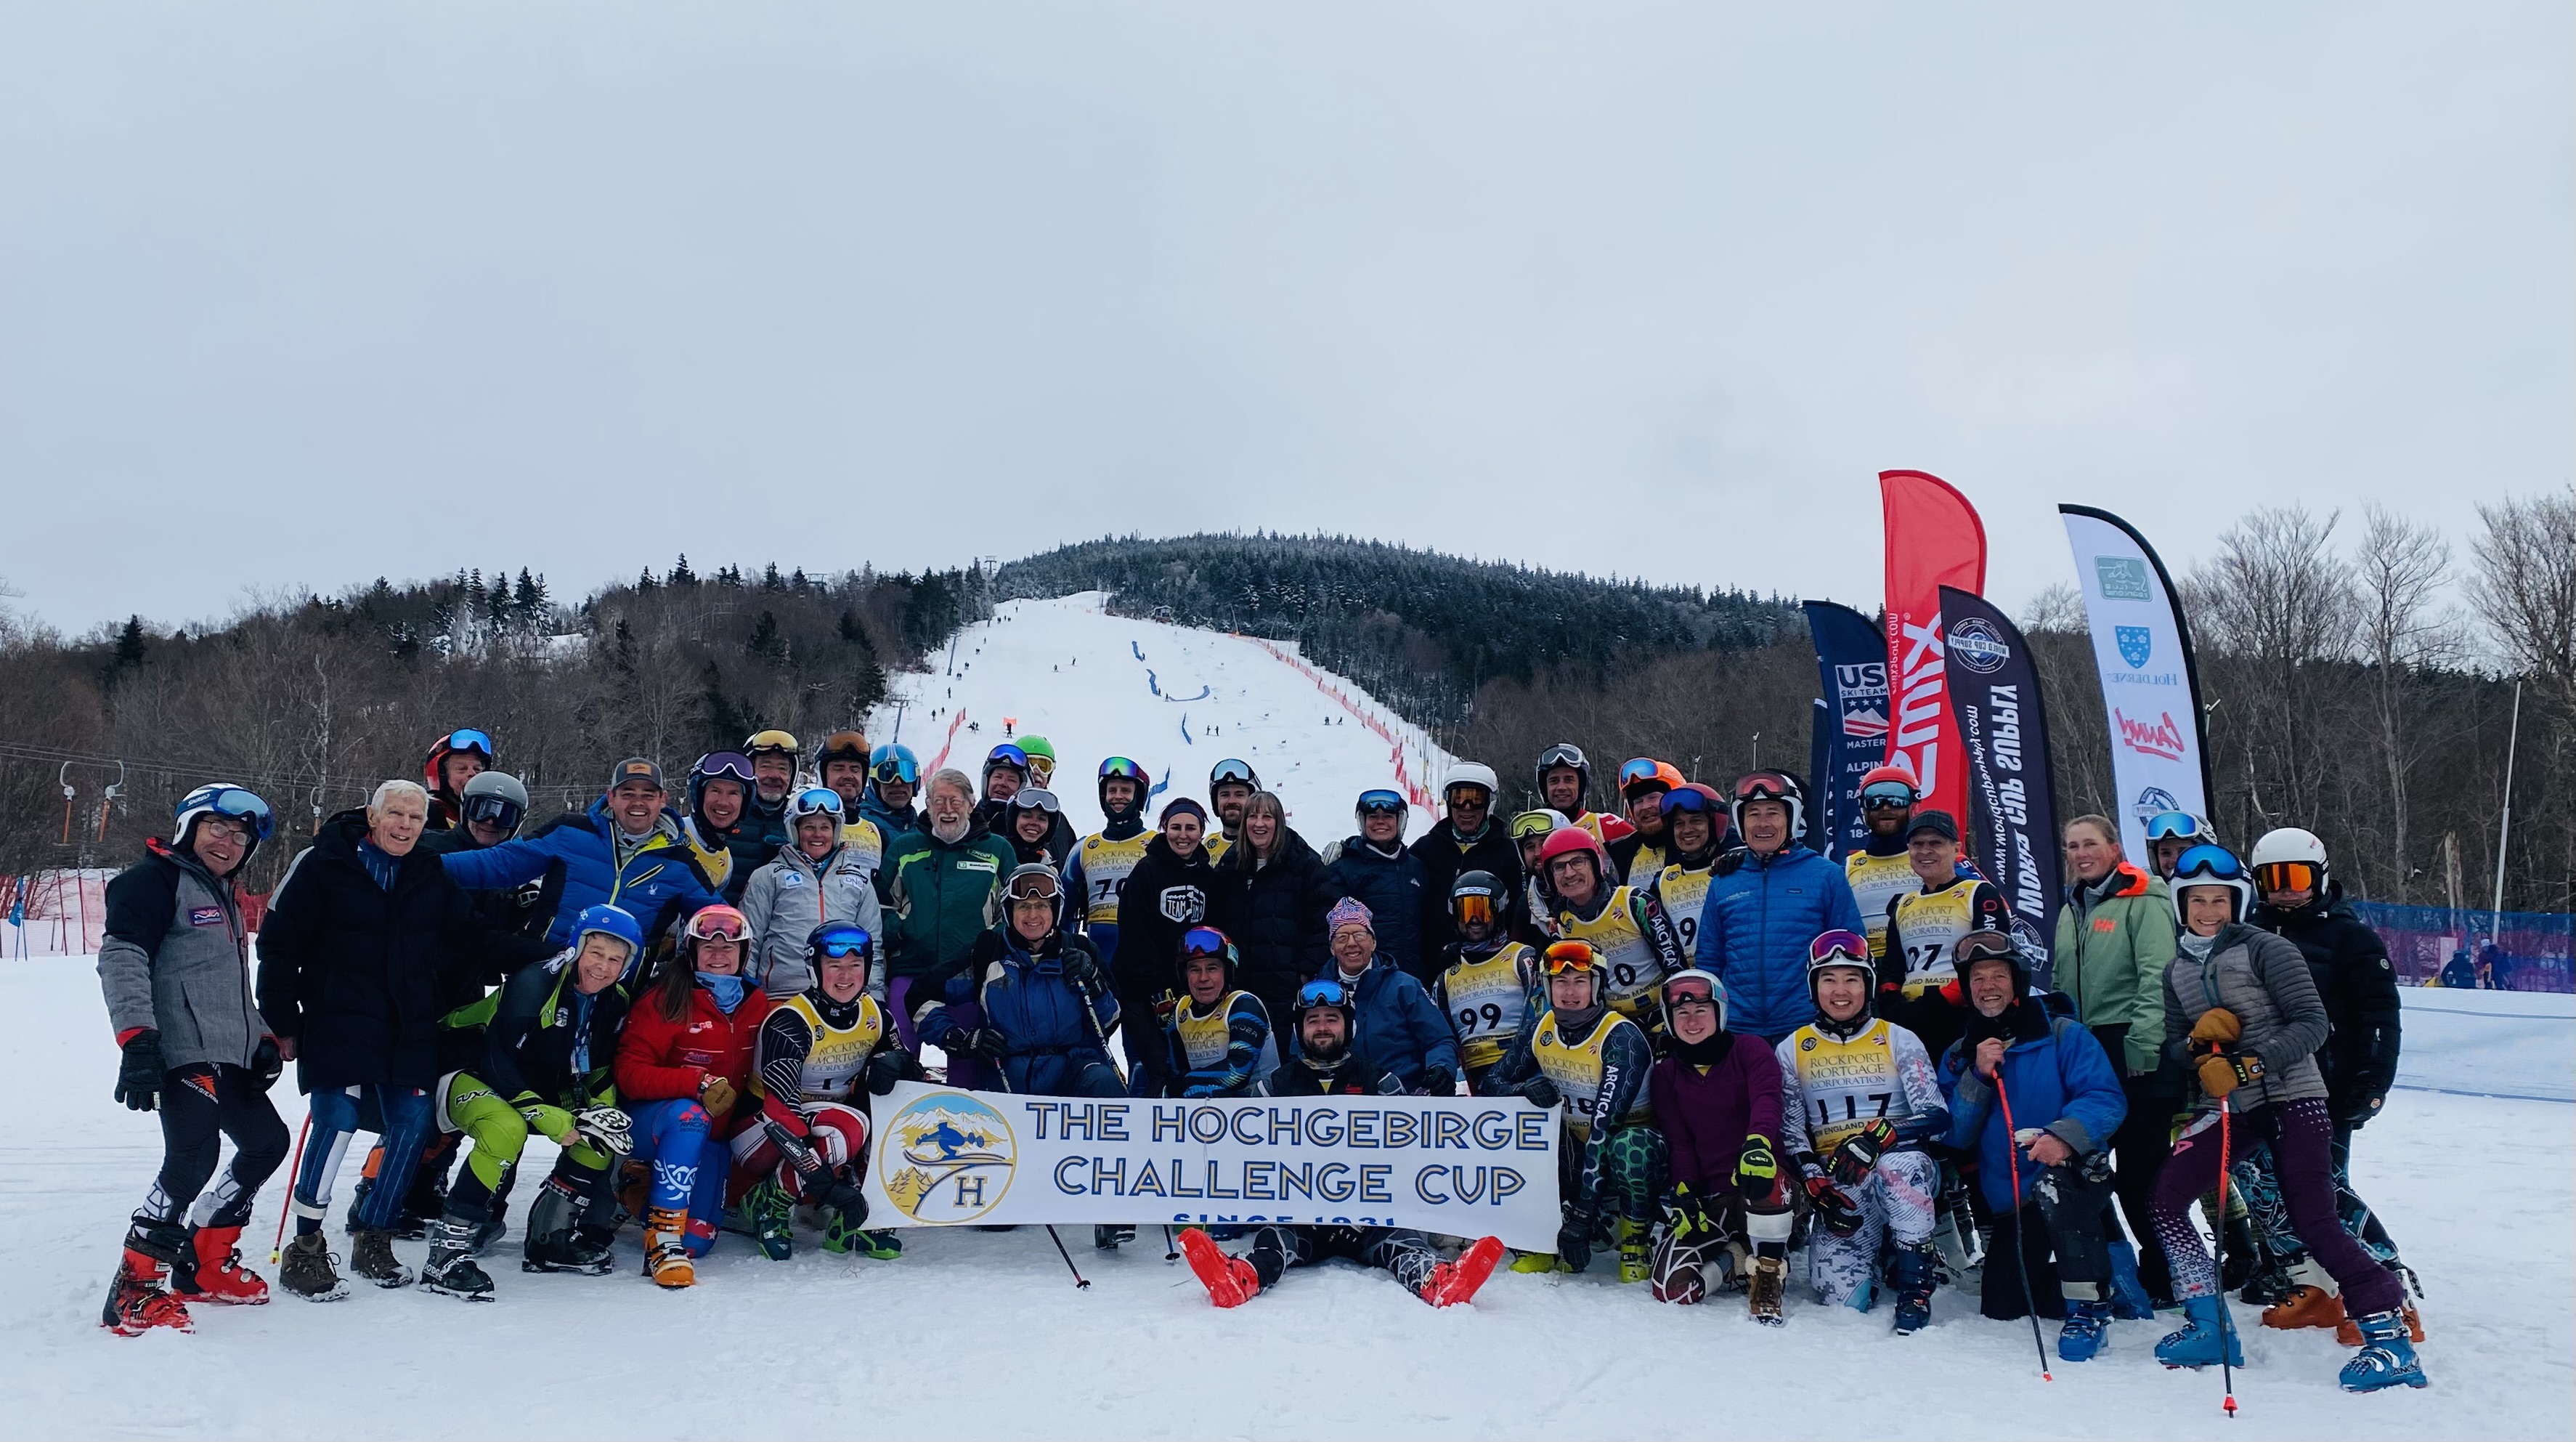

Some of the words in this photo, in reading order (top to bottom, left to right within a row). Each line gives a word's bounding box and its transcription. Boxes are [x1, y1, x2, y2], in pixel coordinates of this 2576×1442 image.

[1837, 665, 1885, 689] US
[1847, 739, 1887, 750] MASTER
[1847, 761, 1884, 773] ALPIN
[1092, 850, 1142, 860] ROCKPORT
[1861, 863, 1912, 876] ROCKPO
[1859, 872, 1919, 885] MORTGAG
[1859, 879, 1924, 892] CORPORATIO
[1670, 880, 1709, 895] ROCKPO
[1670, 889, 1707, 904] MORTG
[1671, 899, 1706, 911] CORPORA
[1651, 917, 1677, 967] ARCTICA
[1905, 944, 1944, 974] 27
[1453, 969, 1503, 987] ROCKPORT
[1452, 979, 1506, 997] MORTGAGE
[1459, 1002, 1502, 1035] 99
[819, 1039, 874, 1056] ROCKPORT
[1543, 1055, 1593, 1074] ROCKPORT
[1810, 1052, 1882, 1069] ROCKPORT
[1543, 1066, 1597, 1084] MORTGAGE
[1811, 1064, 1886, 1080] MORTGAGE
[2237, 1064, 2248, 1082] LEKI
[181, 1077, 198, 1091] HIGH
[198, 1087, 219, 1105] SIERRA
[1811, 1076, 1886, 1089] CORPORATION
[1593, 1065, 1619, 1120] ARCTICA
[1816, 1092, 1893, 1125] 117
[1025, 1102, 1130, 1141] THE
[1151, 1106, 1549, 1151] HOCHGEBIRGE
[1824, 1122, 1864, 1135] ENGLAND
[784, 1141, 803, 1157] SHRED
[1055, 1156, 1392, 1203] CHALLENGE
[1415, 1165, 1526, 1206] CUP
[952, 1174, 988, 1208] H
